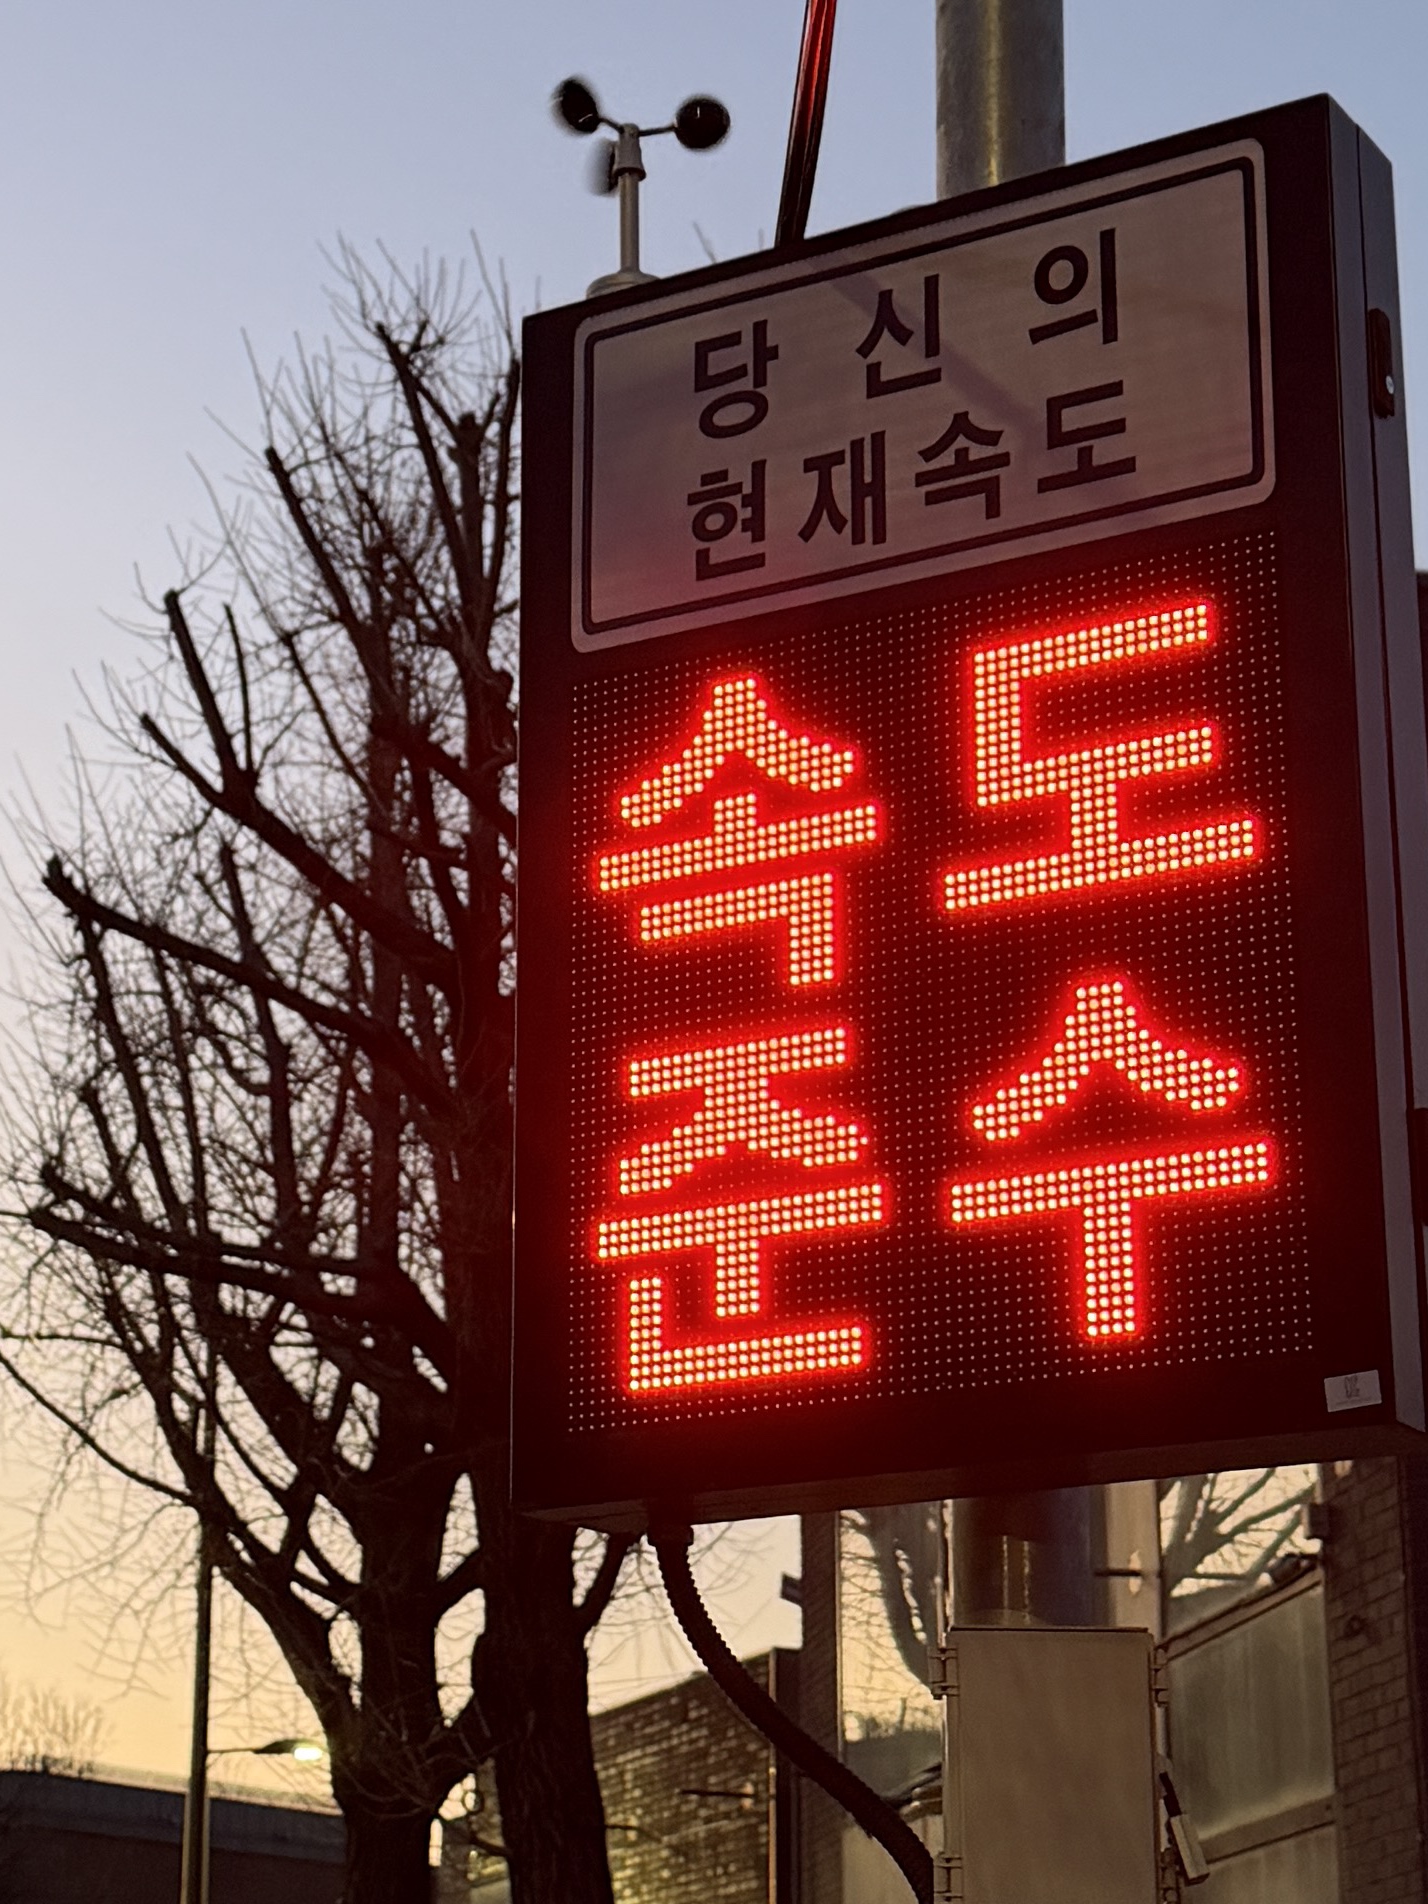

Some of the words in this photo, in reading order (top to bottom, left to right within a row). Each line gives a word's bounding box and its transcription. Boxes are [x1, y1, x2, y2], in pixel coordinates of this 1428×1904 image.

[693, 228, 1117, 440] 당신의
[592, 596, 1265, 988] 속도
[590, 976, 1278, 1396] 준수
